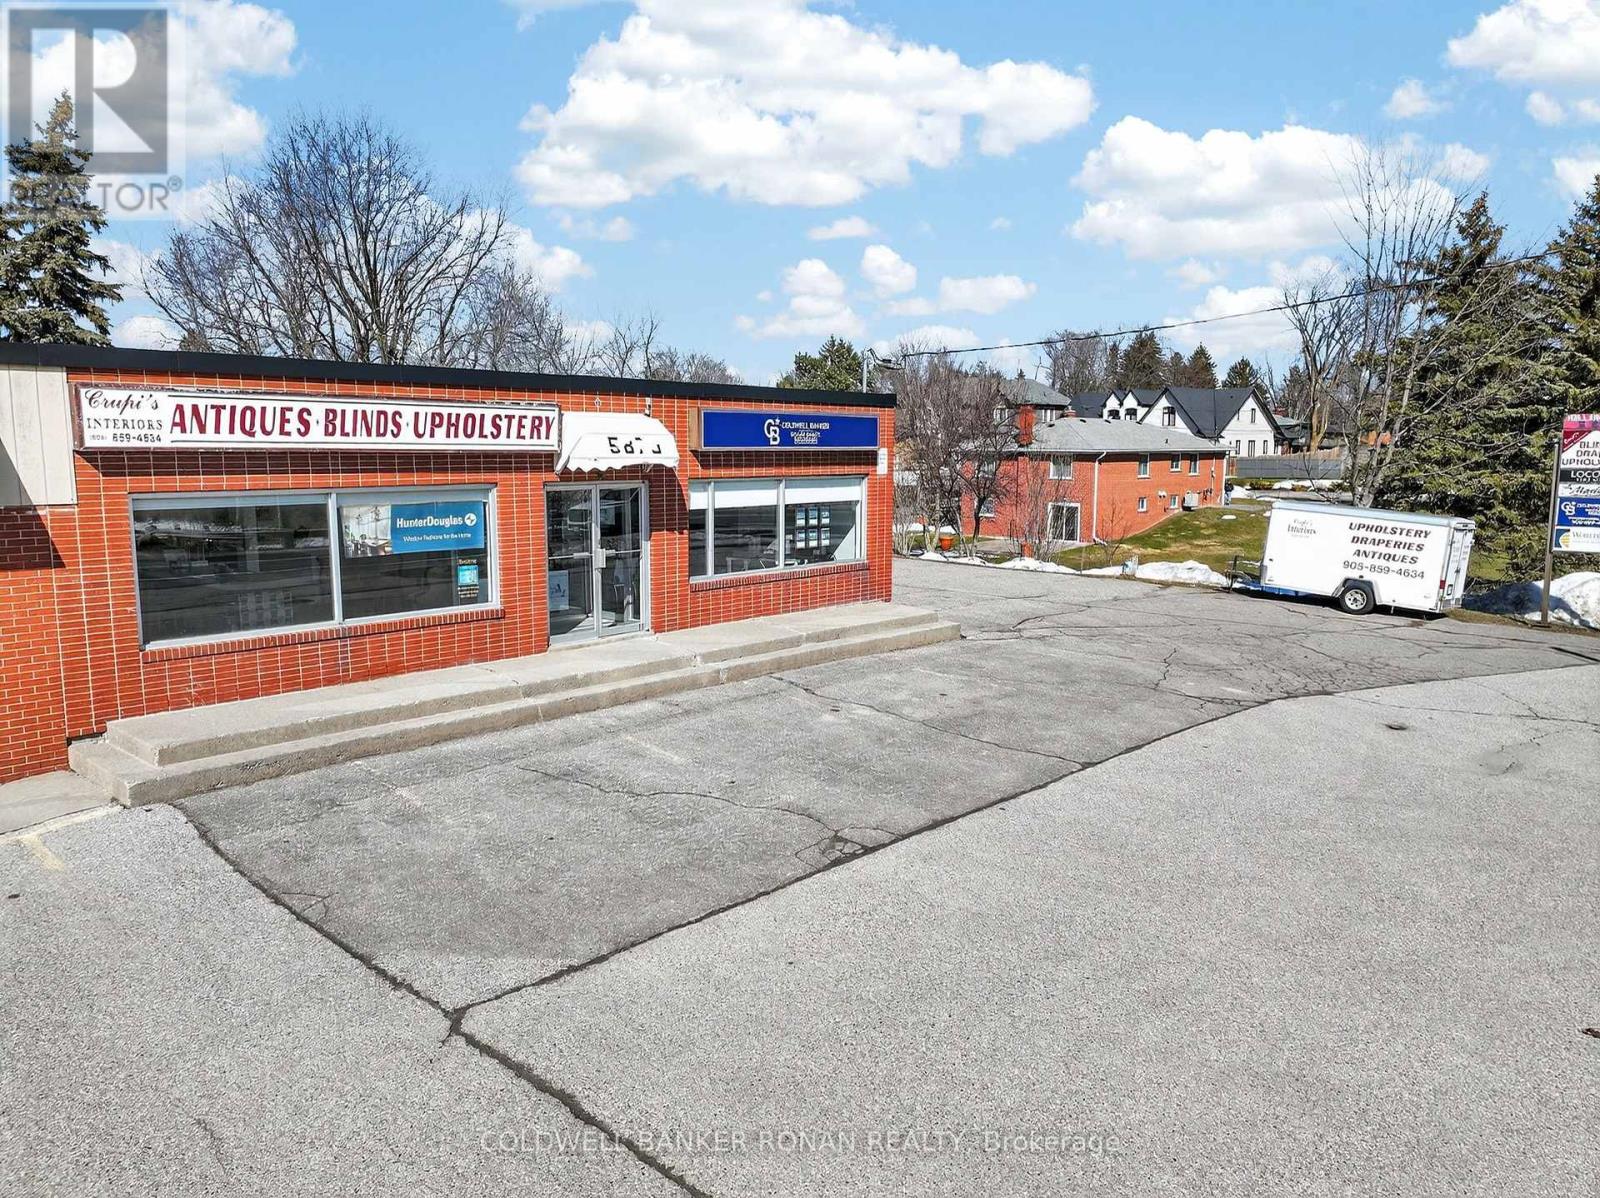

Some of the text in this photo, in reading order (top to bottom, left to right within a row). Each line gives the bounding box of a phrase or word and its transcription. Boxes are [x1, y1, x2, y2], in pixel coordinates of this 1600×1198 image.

[87, 417, 163, 431] INTERIORS
[170, 403, 556, 441] ANTIQUES BLINDS UPHOLSTERY
[1348, 521, 1432, 539] UPHOLSTERY
[1350, 535, 1425, 552] DRAPERIES
[1352, 548, 1419, 565] ANTIQUES
[1342, 560, 1425, 579] 905-859-4634
